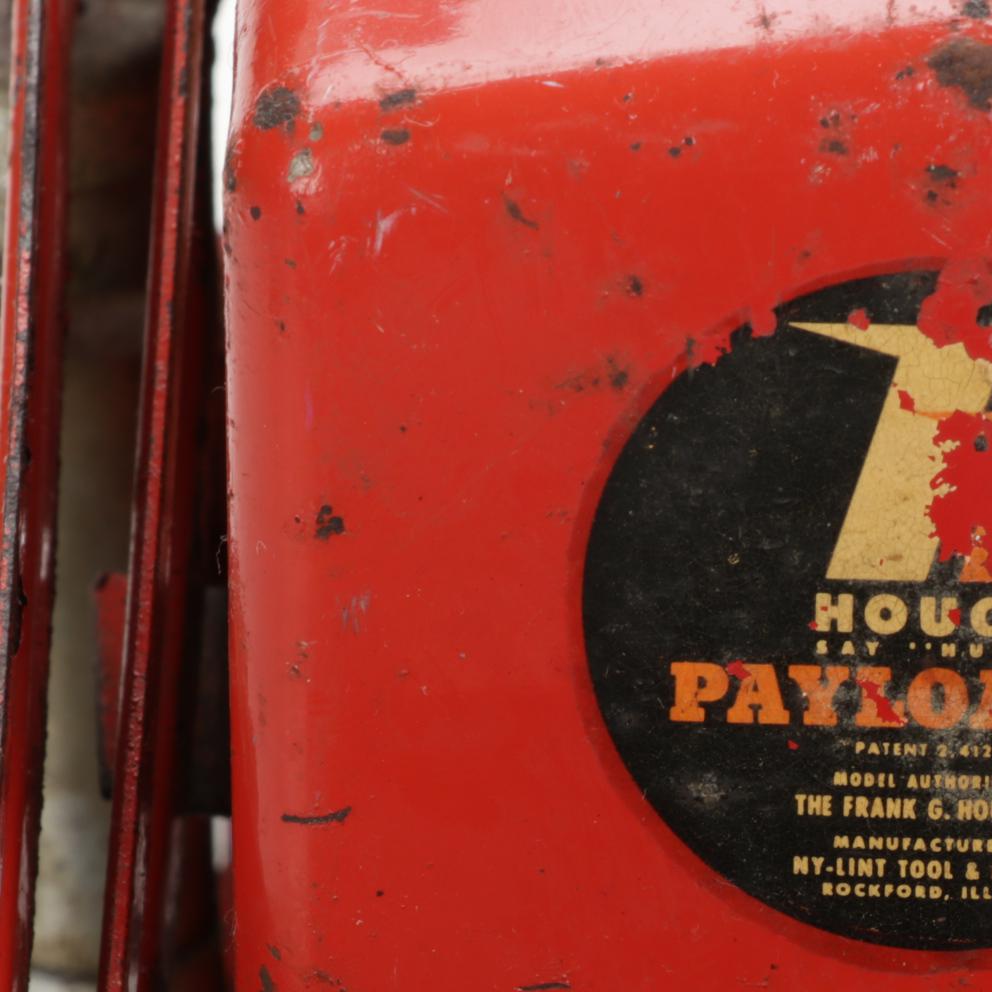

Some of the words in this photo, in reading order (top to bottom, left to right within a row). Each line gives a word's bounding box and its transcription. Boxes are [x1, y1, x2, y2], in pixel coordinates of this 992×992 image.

[816, 640, 880, 656] SAY
[855, 741, 928, 757] PATENT
[833, 771, 896, 788] MODEL
[795, 793, 832, 816] THE
[843, 795, 917, 819] FRANK
[927, 799, 951, 820] G.
[793, 855, 887, 878] NY-LINT
[898, 858, 954, 880] TOOL
[964, 861, 980, 881] &
[822, 882, 951, 901] ROCKFORD,
